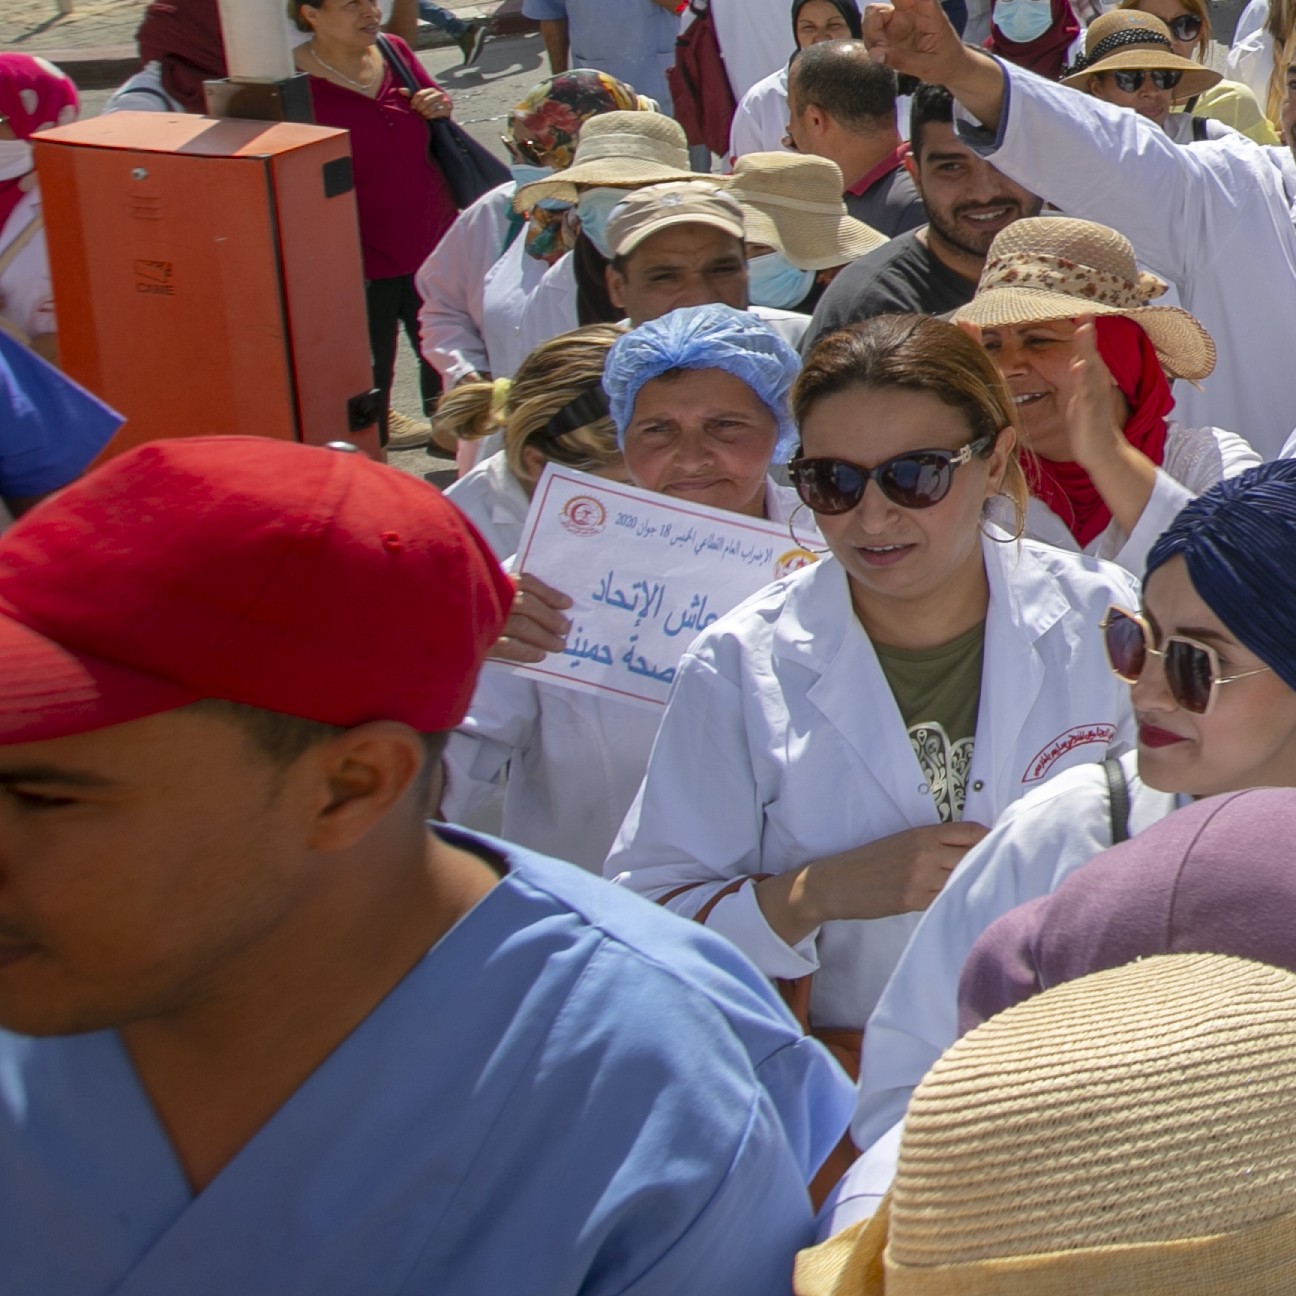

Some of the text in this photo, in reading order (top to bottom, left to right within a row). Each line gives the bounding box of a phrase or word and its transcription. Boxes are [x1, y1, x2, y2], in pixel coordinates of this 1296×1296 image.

[614, 512, 638, 529] 2020
[636, 519, 657, 538] جوان
[659, 523, 672, 538] 18
